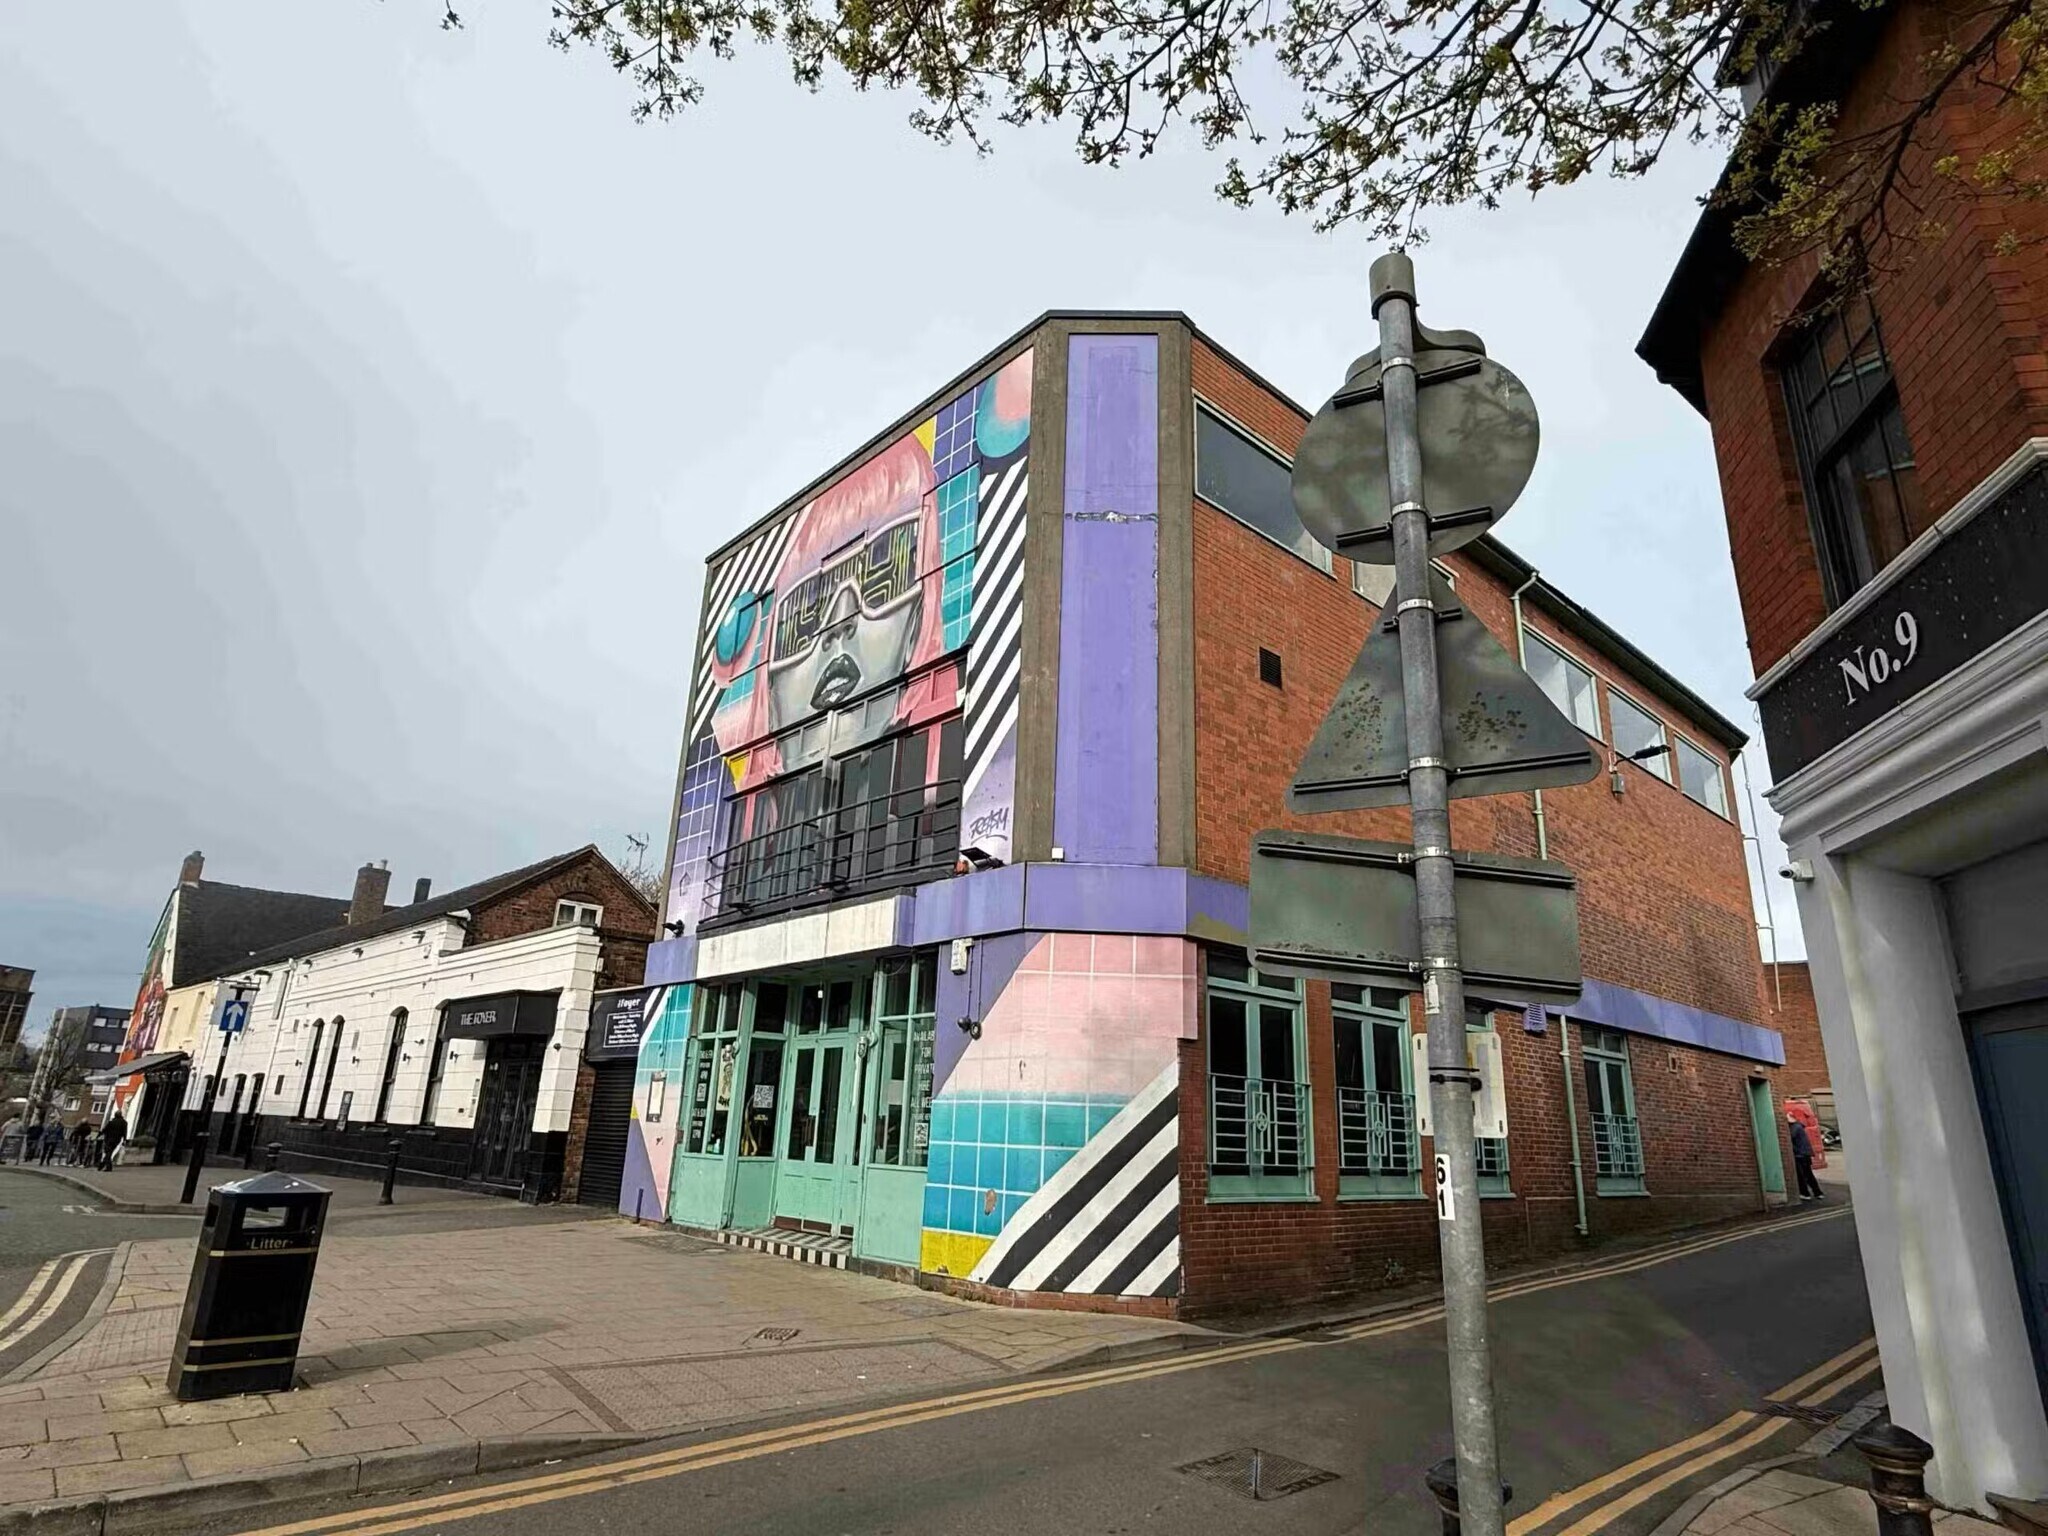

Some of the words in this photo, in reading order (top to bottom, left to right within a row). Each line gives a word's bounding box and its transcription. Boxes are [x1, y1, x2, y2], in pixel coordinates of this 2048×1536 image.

[1838, 611, 1919, 706] No.9
[460, 1013, 473, 1026] THE
[474, 1010, 497, 1025] FOYER
[921, 1046, 932, 1058] FOR
[249, 1236, 289, 1250] Litter
